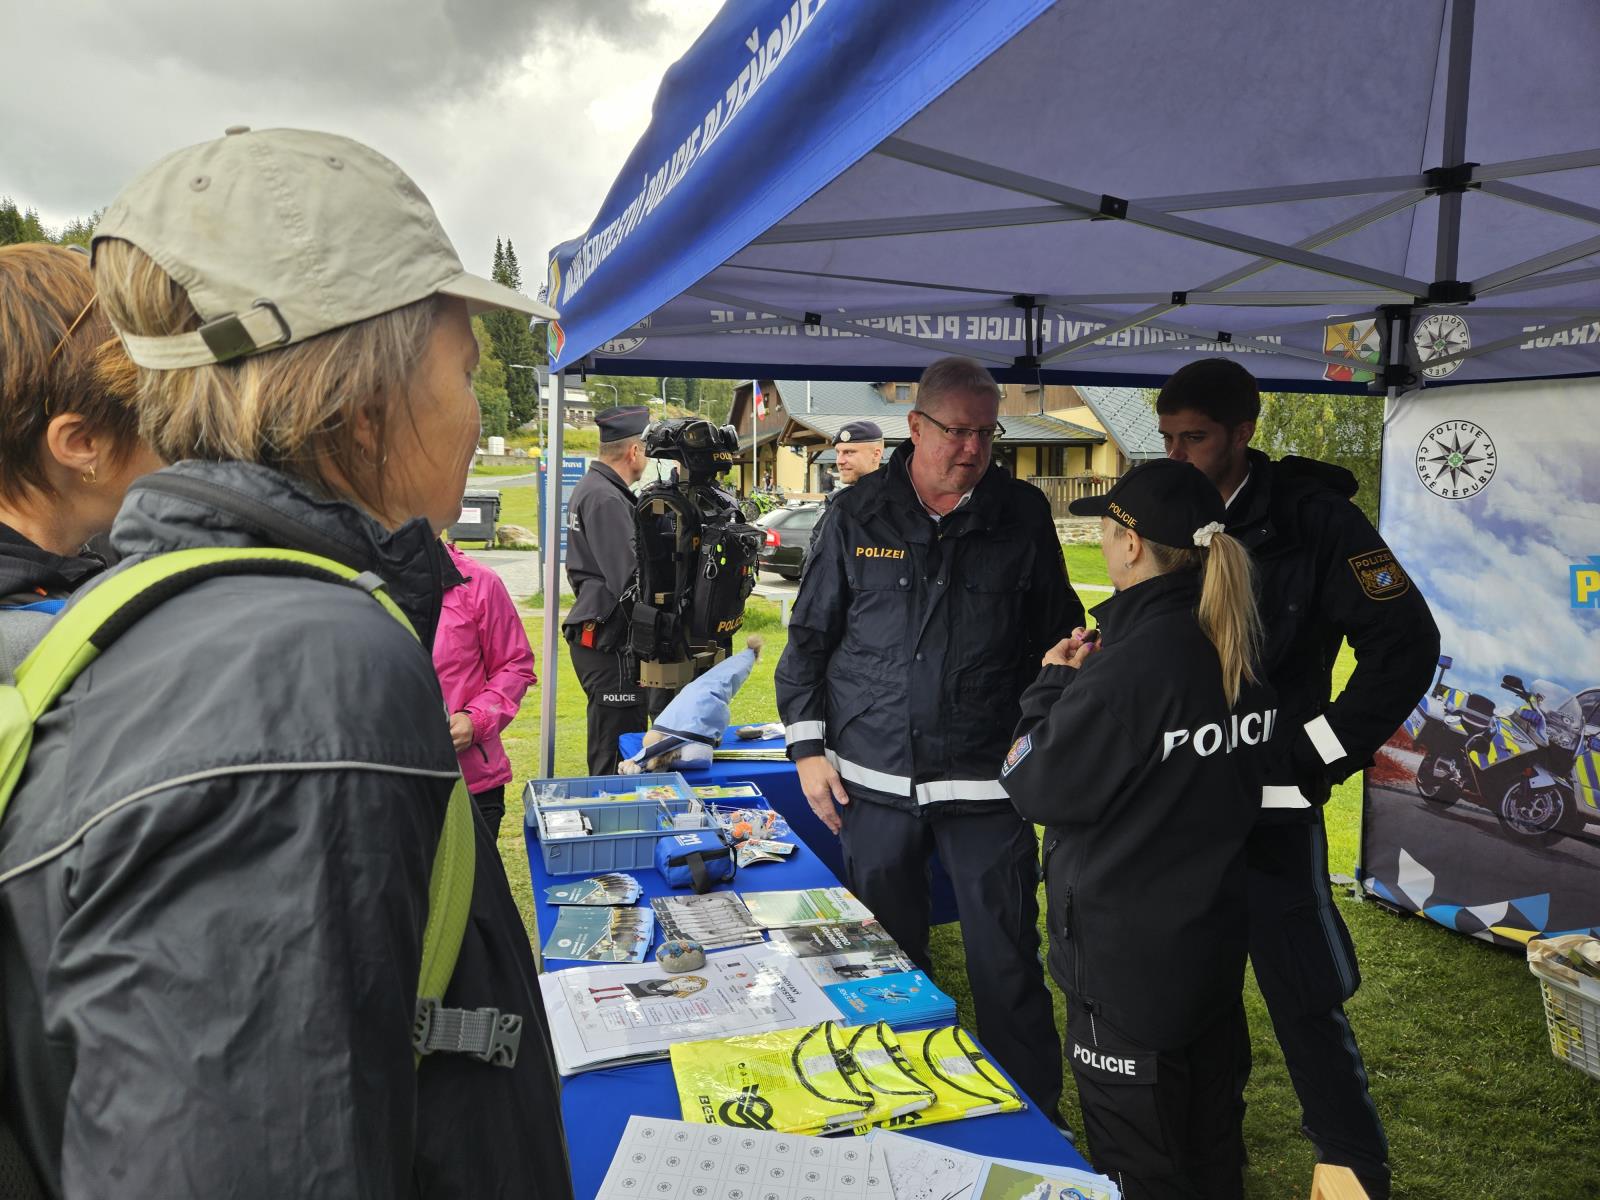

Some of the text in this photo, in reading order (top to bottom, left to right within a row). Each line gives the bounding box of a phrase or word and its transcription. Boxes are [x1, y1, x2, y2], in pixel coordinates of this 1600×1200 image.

[645, 124, 701, 217] POLICIE
[1429, 423, 1482, 441] POLICIE
[1419, 443, 1494, 497] ČESKÉ REPUBLIKY
[1108, 502, 1138, 528] POLICIE
[856, 547, 905, 559] POLIZEI
[603, 694, 636, 702] POLICIE
[1160, 709, 1277, 762] POICI
[1074, 1043, 1136, 1075] POLICIE
